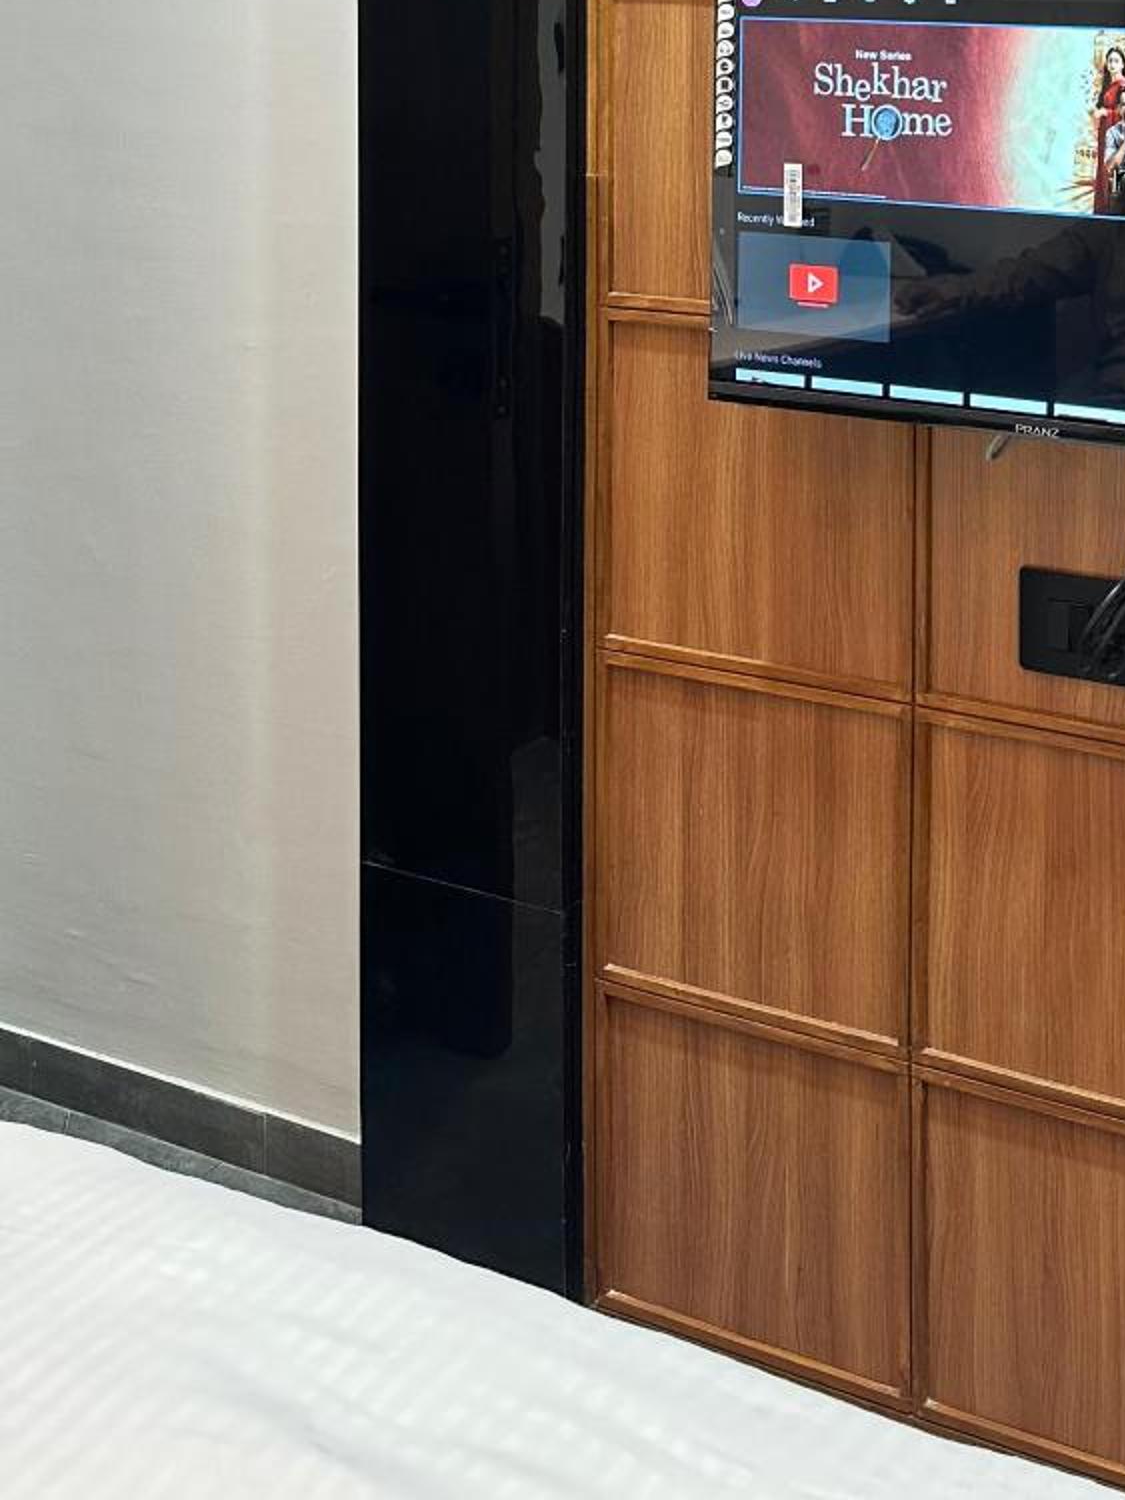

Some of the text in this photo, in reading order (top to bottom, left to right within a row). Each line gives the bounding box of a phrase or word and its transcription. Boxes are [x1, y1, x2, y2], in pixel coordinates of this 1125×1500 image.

[855, 49, 912, 61] New Series
[813, 61, 948, 103] Shekhar
[737, 211, 774, 227] Recently
[780, 354, 823, 369] Channels
